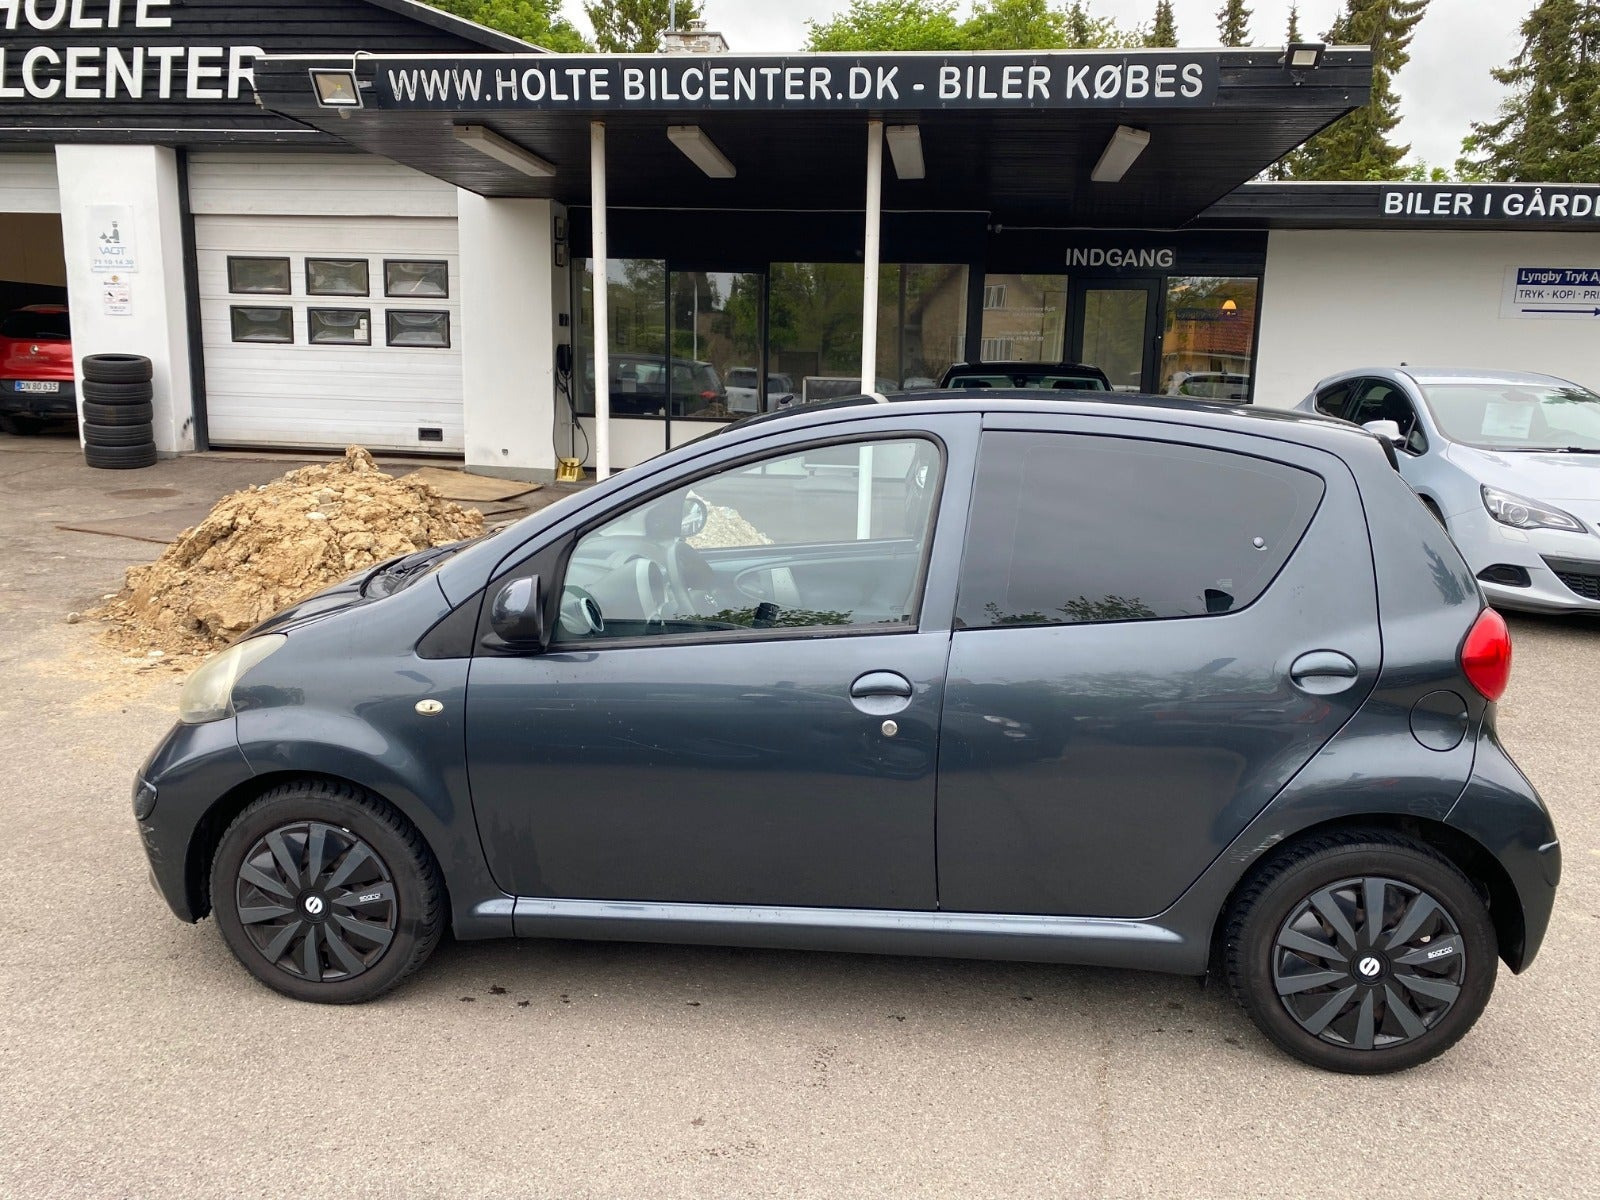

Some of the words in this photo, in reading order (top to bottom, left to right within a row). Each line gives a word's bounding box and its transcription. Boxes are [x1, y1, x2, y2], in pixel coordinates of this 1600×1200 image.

[388, 67, 610, 101] WWW.HOLTE
[623, 66, 900, 101] BILCENTER.DK
[938, 65, 1052, 100] BILER
[1066, 63, 1203, 99] KØBES
[1384, 192, 1473, 215] BILER
[1484, 193, 1492, 216] I
[1065, 247, 1173, 267] INDGANG
[1521, 270, 1562, 284] Lyngby
[1565, 271, 1589, 284] Tryk
[1519, 289, 1545, 299] TRYK
[1552, 289, 1576, 299] KOPI
